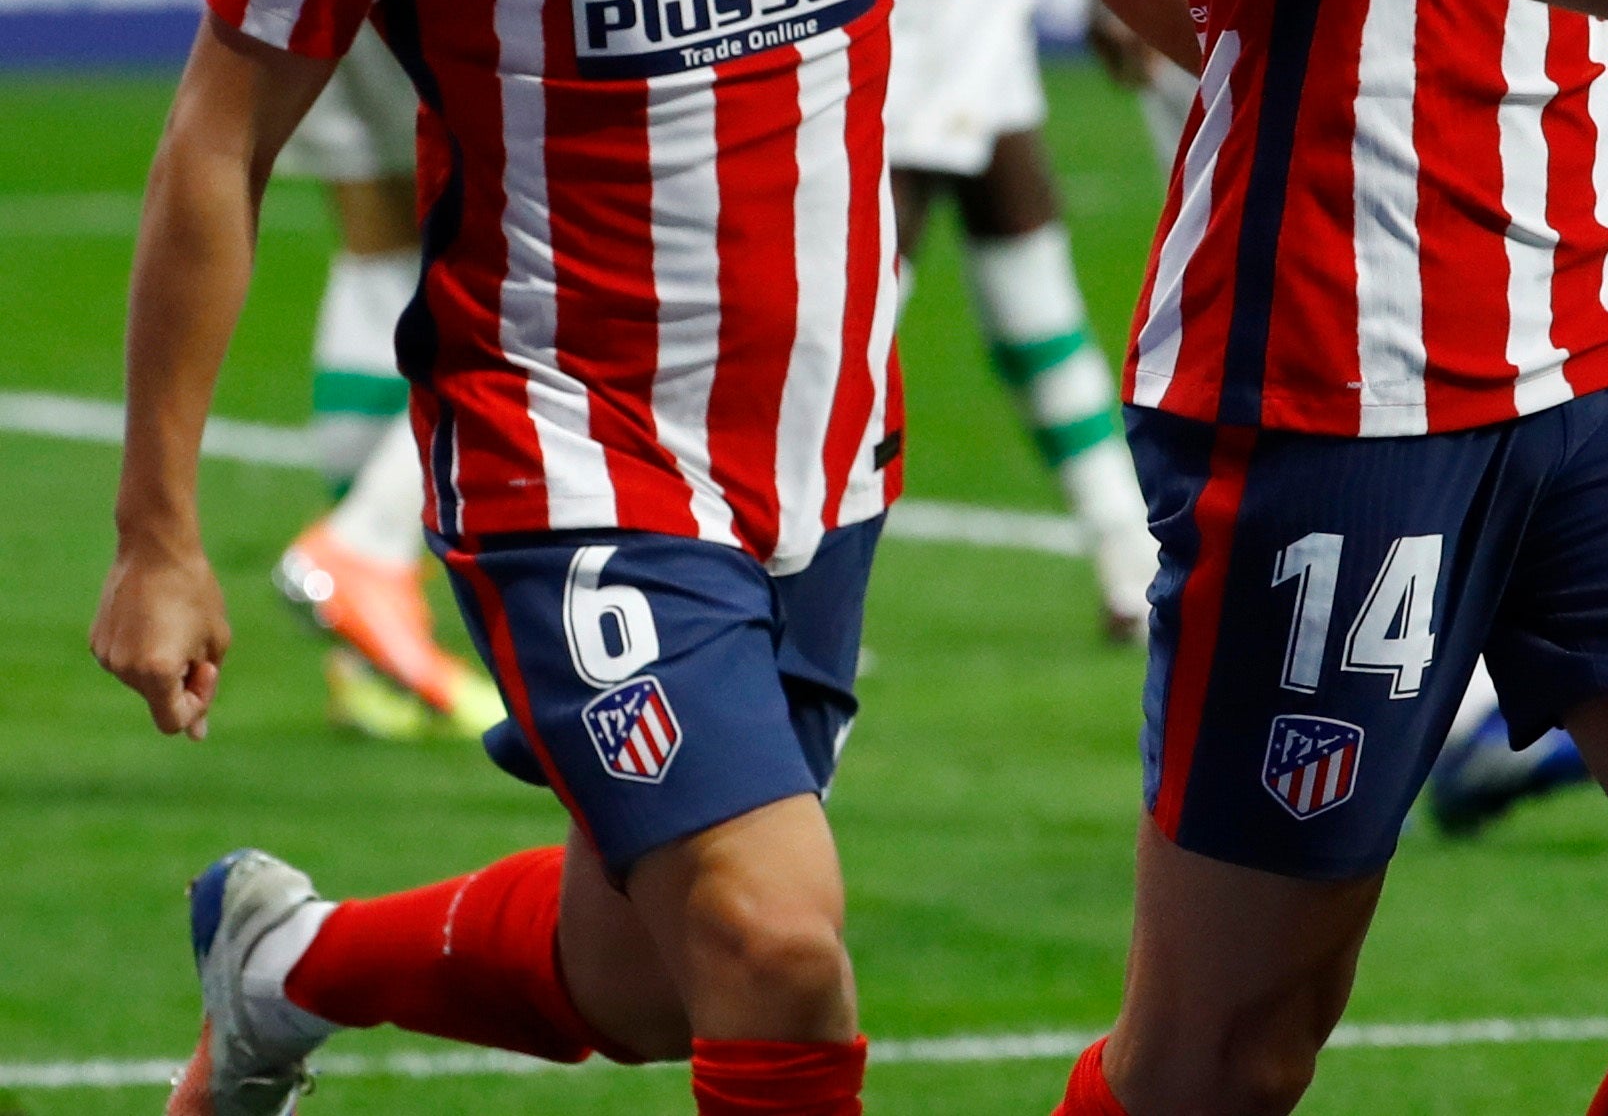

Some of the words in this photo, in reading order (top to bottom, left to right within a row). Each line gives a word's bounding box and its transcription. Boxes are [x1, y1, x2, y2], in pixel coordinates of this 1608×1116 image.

[680, 36, 743, 69] Trade
[749, 17, 819, 49] Online
[562, 544, 660, 690] 6
[1270, 531, 1444, 700] 14
